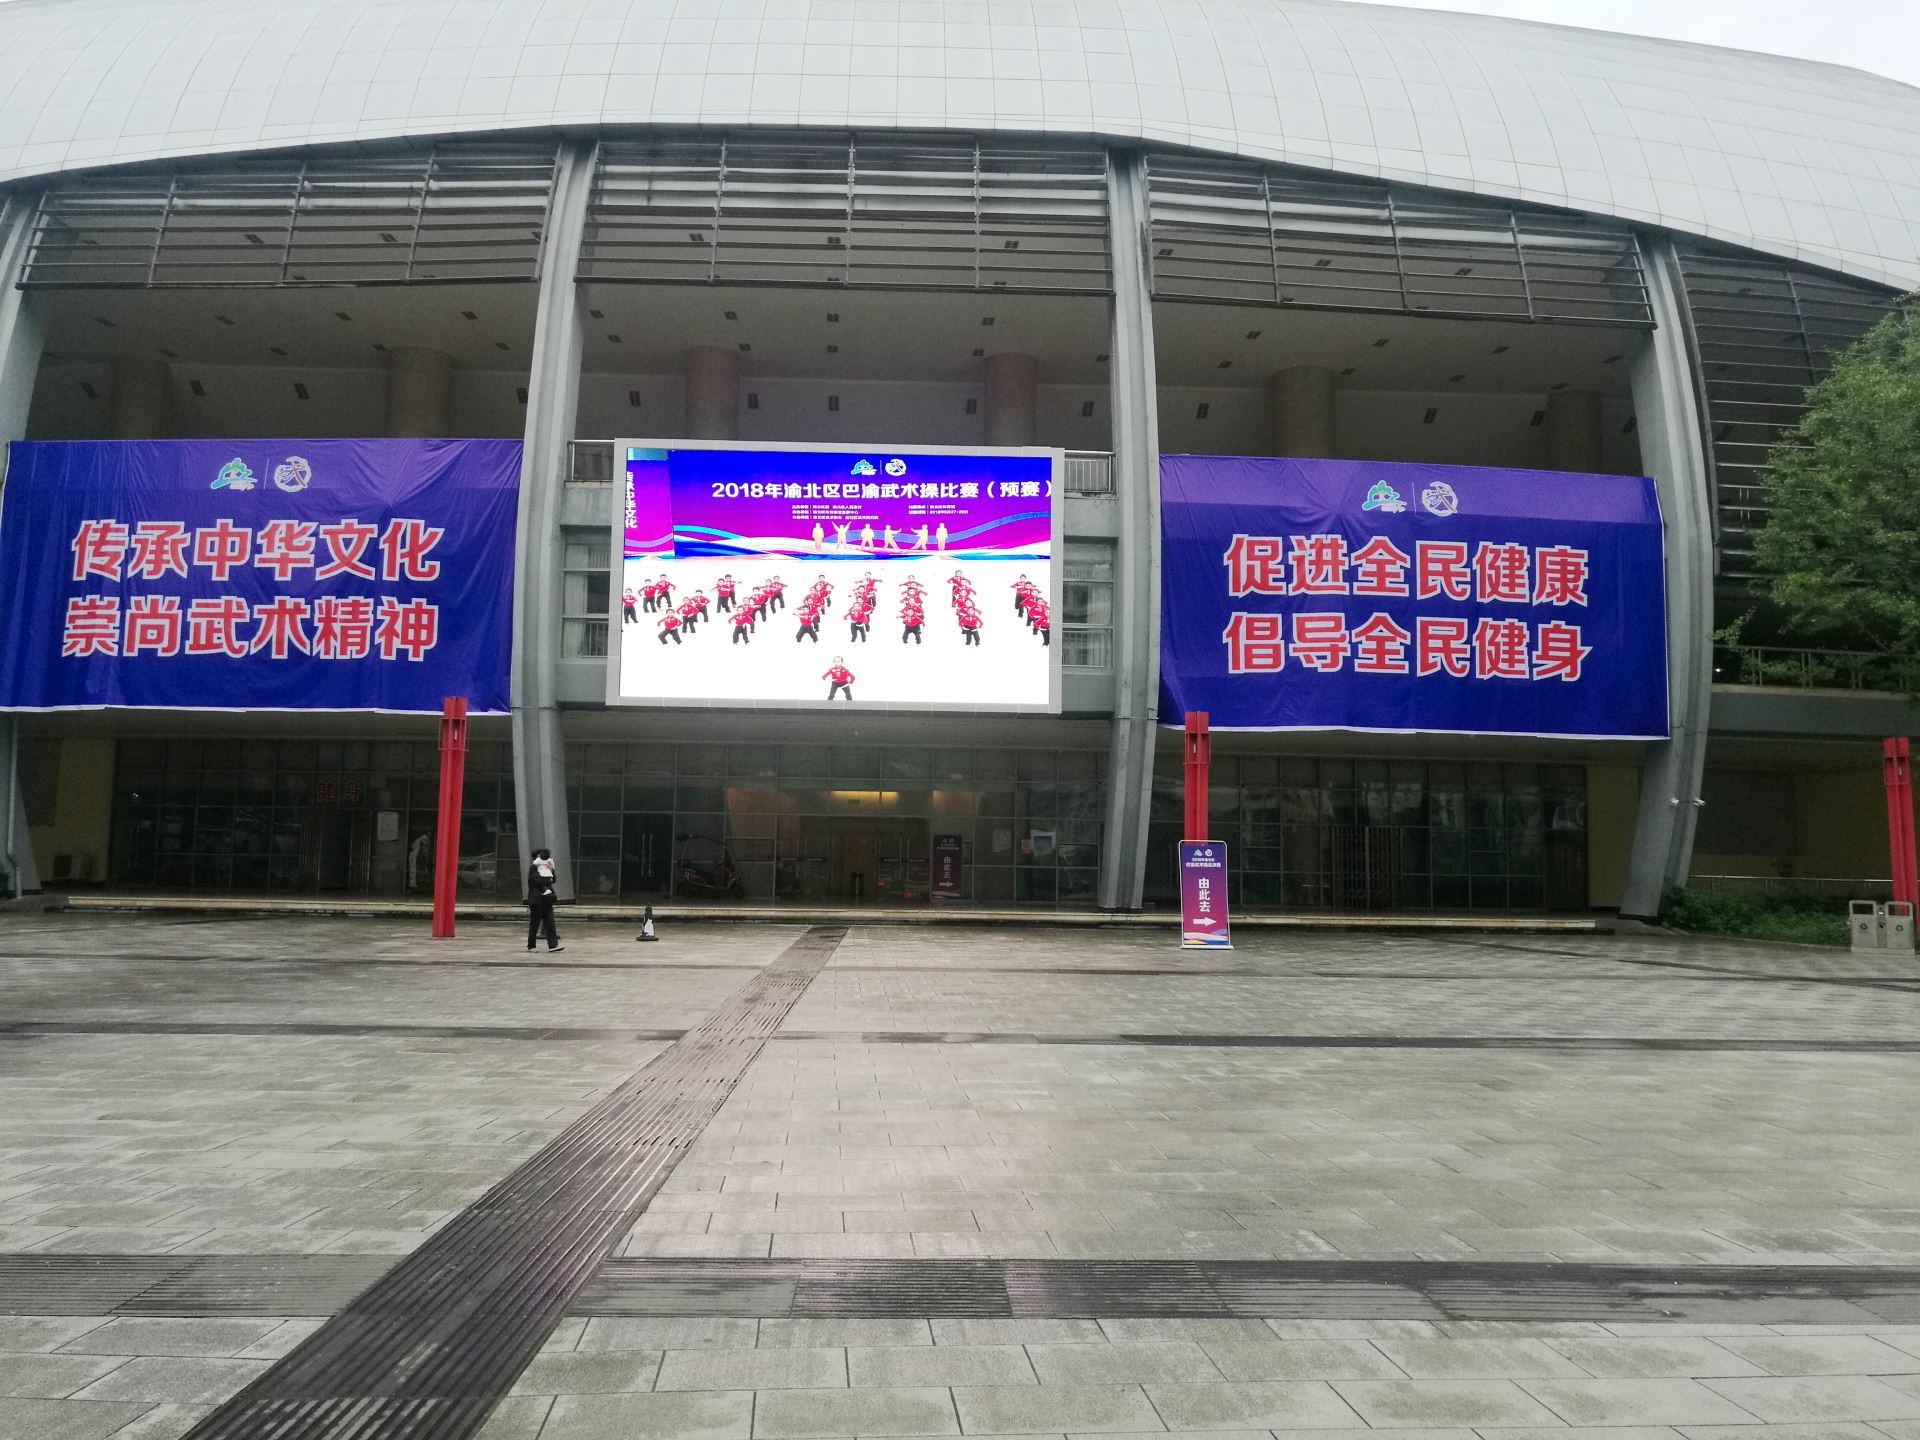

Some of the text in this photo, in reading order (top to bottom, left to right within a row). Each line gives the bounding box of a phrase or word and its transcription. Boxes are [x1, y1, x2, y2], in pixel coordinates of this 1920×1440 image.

[71, 518, 446, 582] 传承中华文化
[1223, 533, 1590, 608] 促进全民健康
[61, 594, 440, 662] 崇尚武术精神
[1222, 611, 1594, 682] 倡导全民健身
[943, 856, 953, 880] 由此去
[1198, 877, 1211, 913] 由此去
